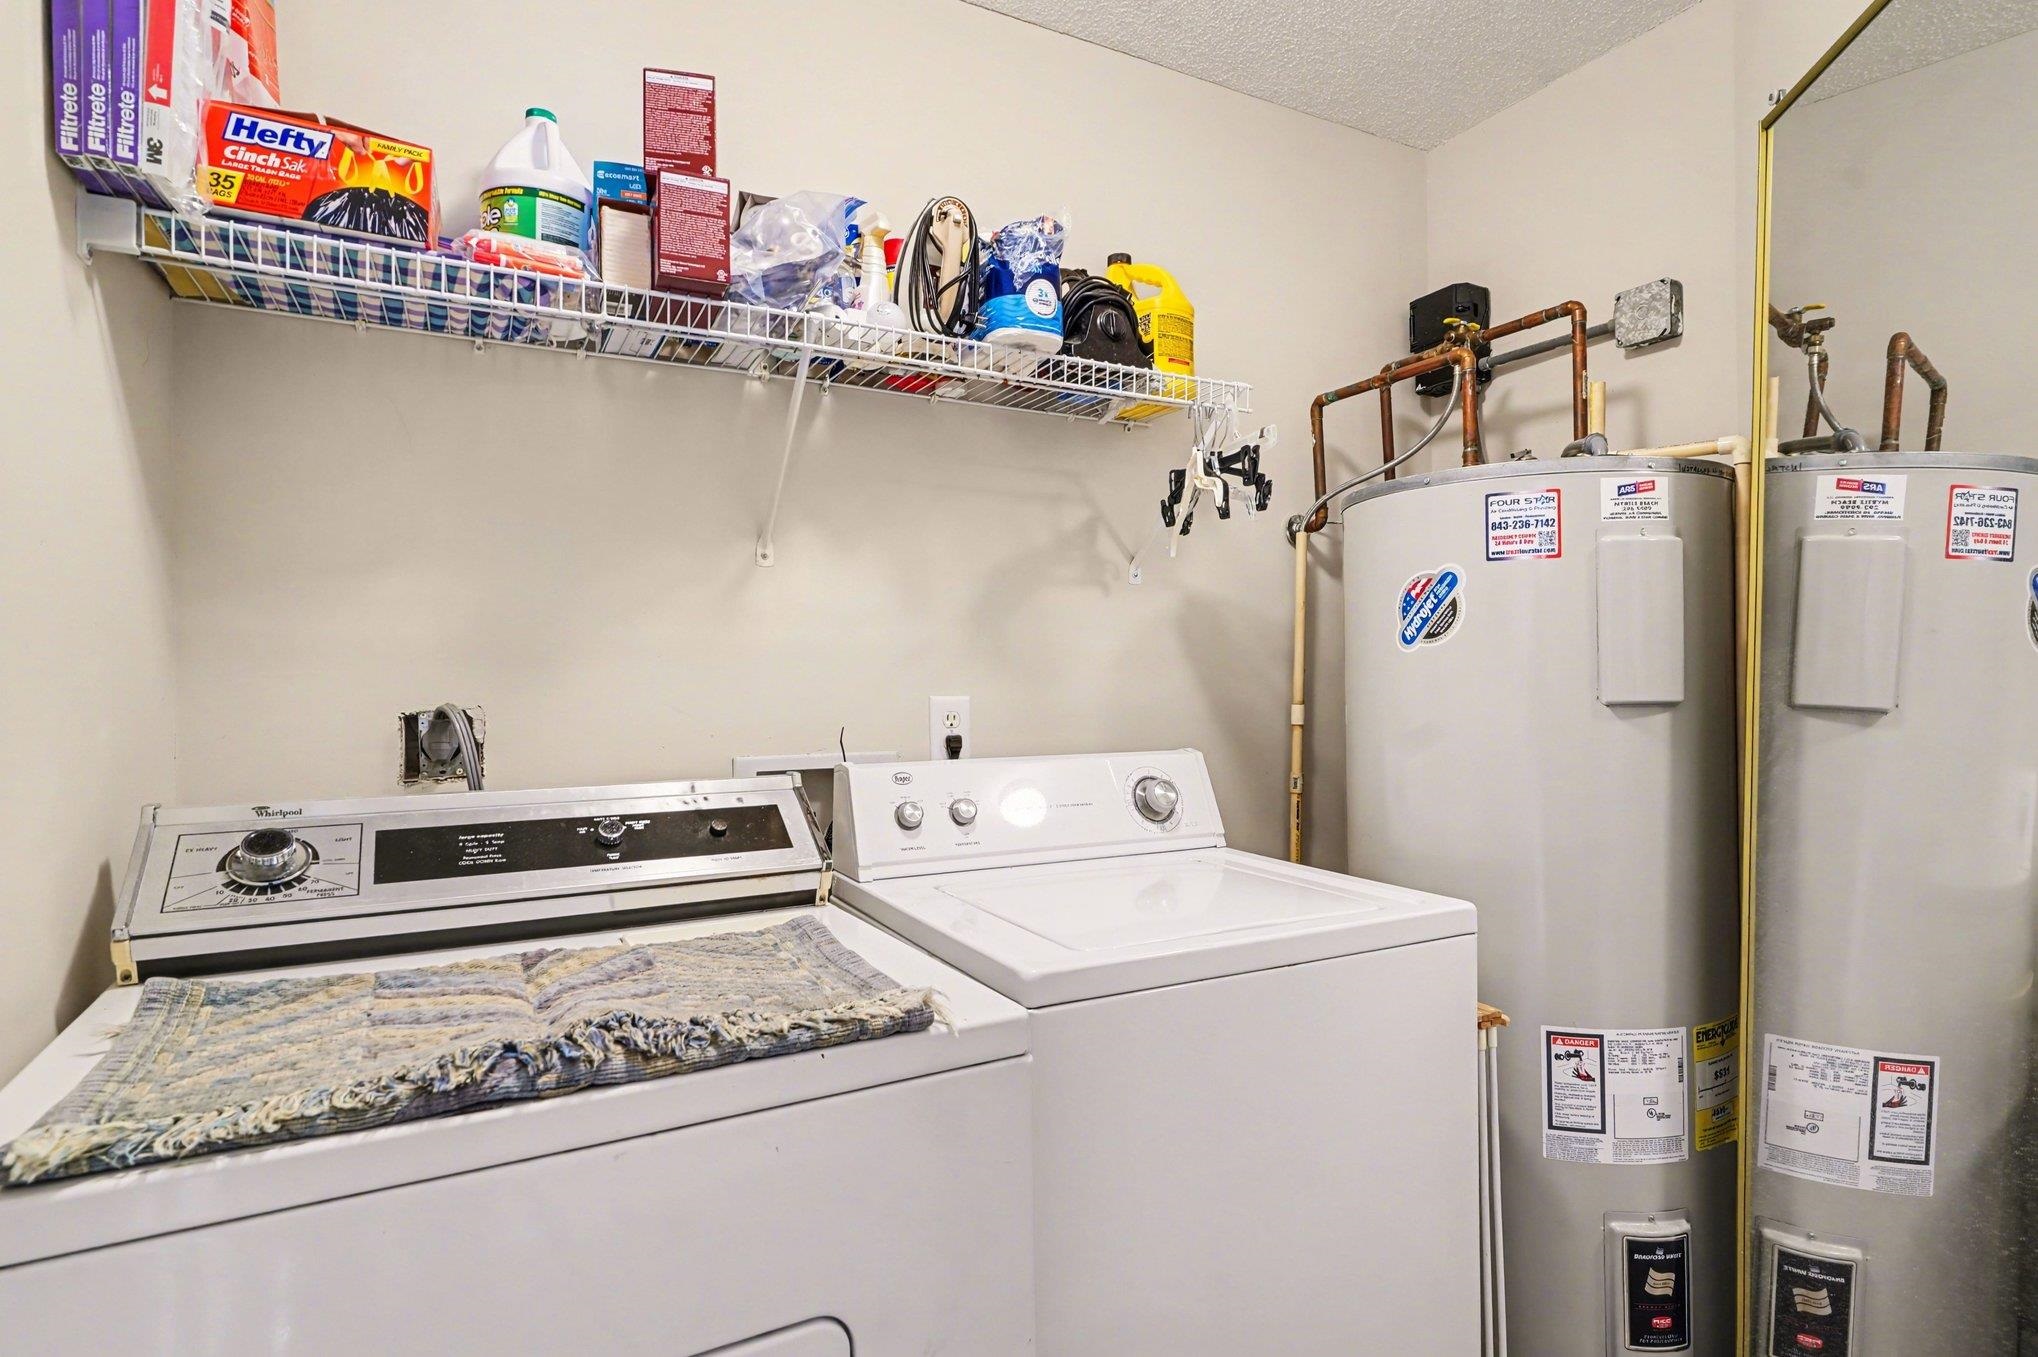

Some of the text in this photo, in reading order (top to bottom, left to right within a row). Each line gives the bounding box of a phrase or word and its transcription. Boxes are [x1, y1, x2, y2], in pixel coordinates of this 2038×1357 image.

[60, 82, 80, 152] Filtrete
[87, 82, 106, 153] Filtrete
[116, 90, 135, 160] Filtrete
[231, 117, 327, 158] Hefty
[146, 137, 163, 165] 3M
[223, 145, 304, 173] Cinch Sak
[208, 172, 236, 190] 35
[604, 172, 640, 182] ecosmart
[1619, 484, 1636, 494] ARS
[1490, 495, 1556, 507] FOUR STAR
[1491, 518, 1556, 531] 843-236-7142
[1403, 591, 1438, 641] Hydrojet
[255, 808, 303, 819] Whirlpool
[1564, 1039, 1596, 1047] DANGER
